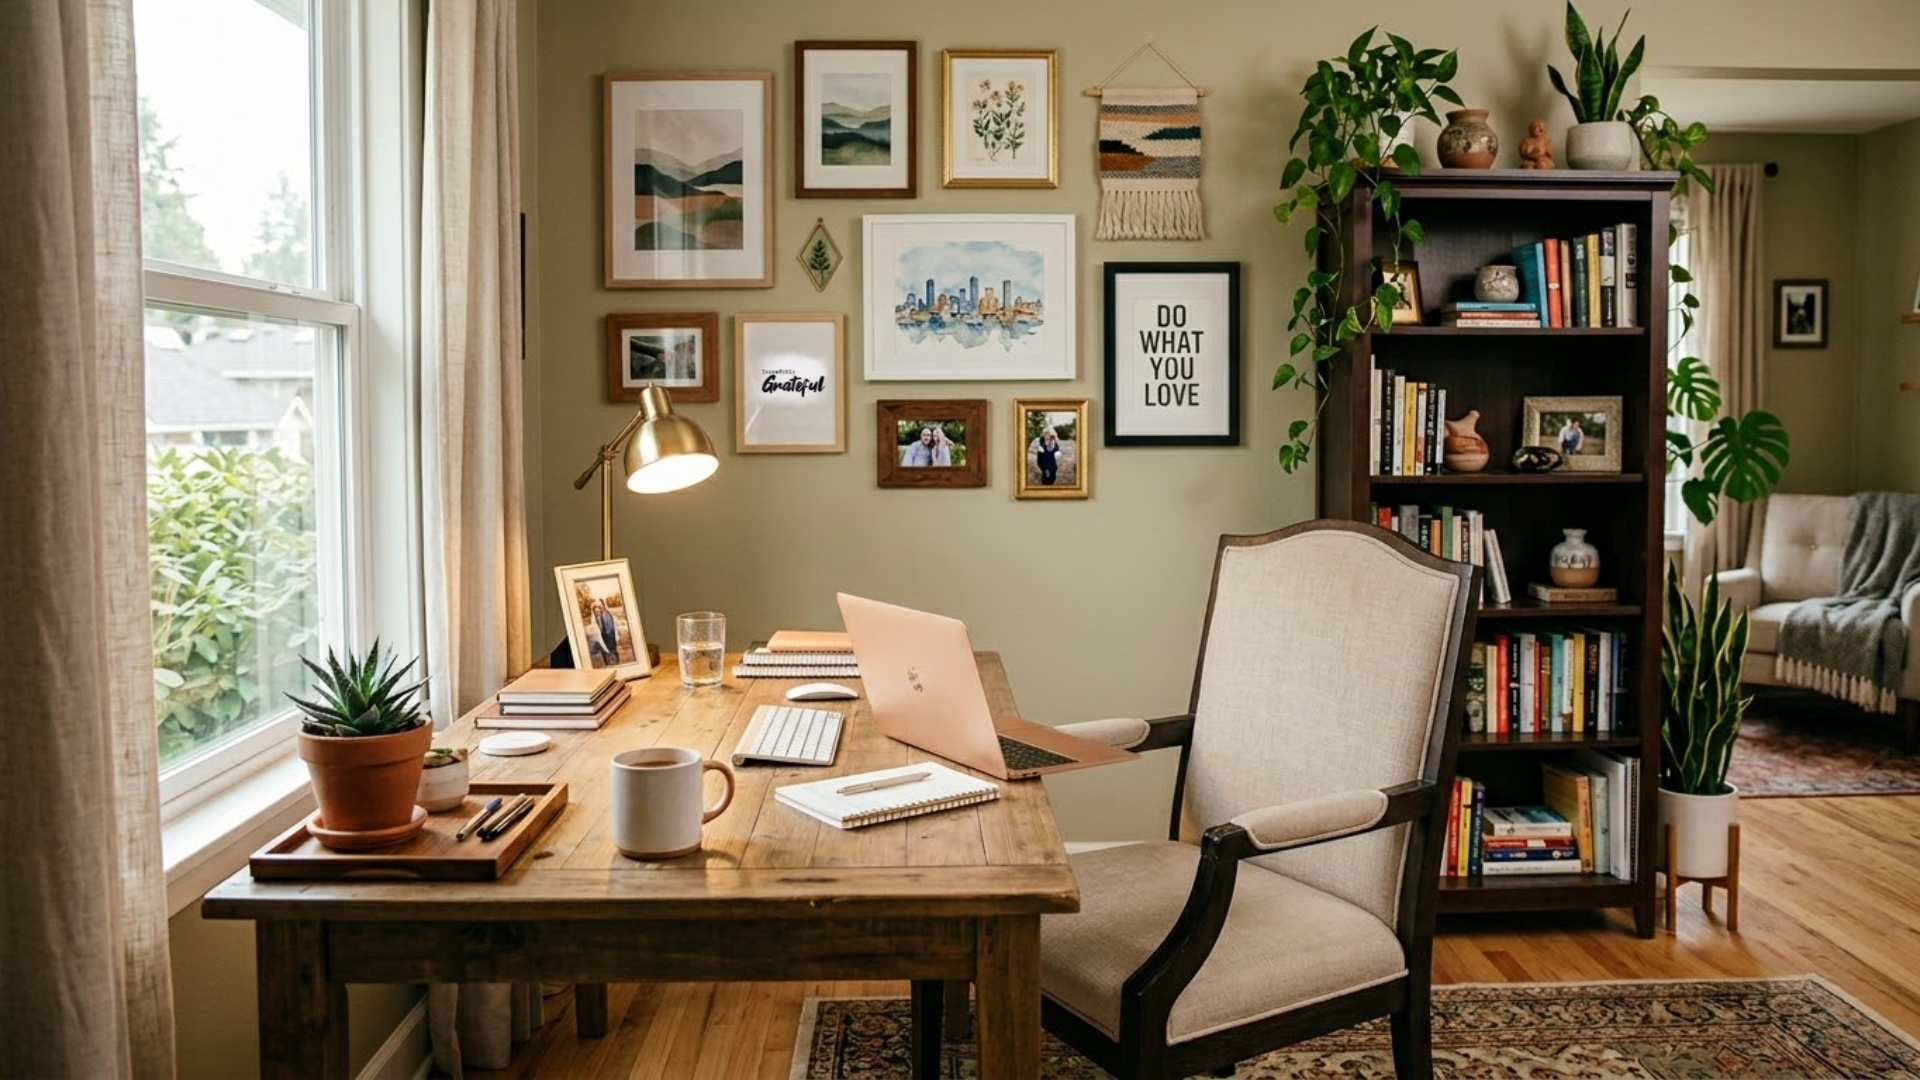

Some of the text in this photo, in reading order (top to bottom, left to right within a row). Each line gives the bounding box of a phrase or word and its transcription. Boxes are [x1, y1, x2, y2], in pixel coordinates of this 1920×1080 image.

[1157, 305, 1186, 328] DO
[1139, 330, 1204, 353] WHAT
[1150, 357, 1194, 380] YOU
[762, 374, 826, 397] Grateful
[1145, 383, 1200, 406] LOVE
